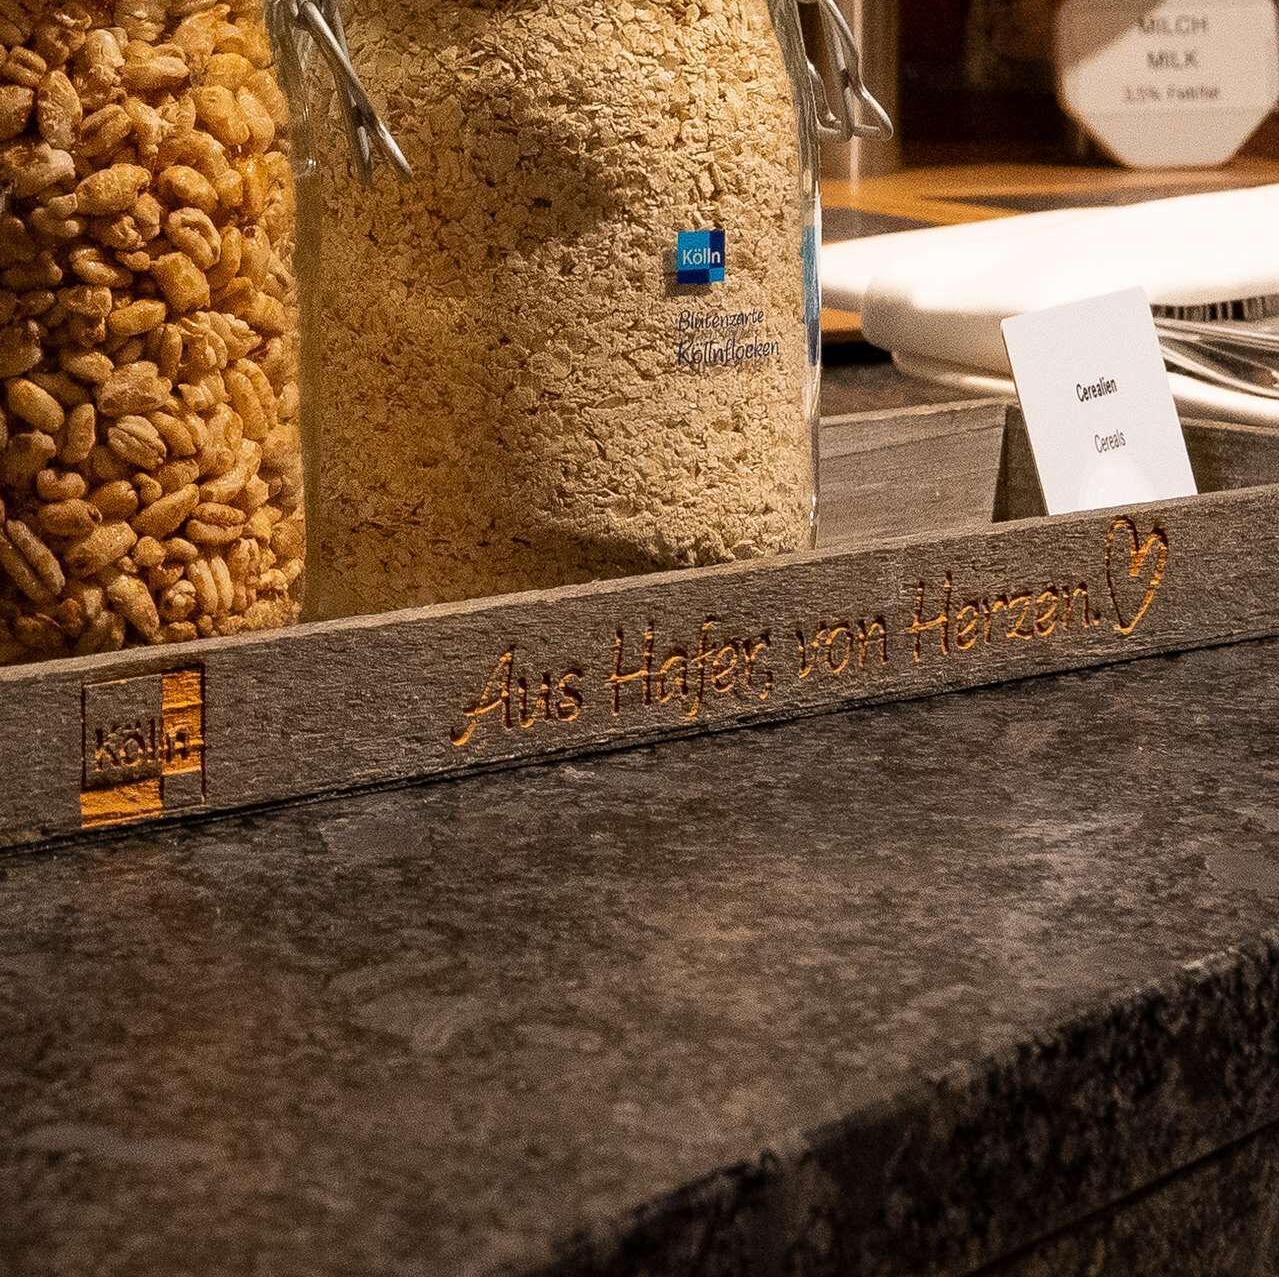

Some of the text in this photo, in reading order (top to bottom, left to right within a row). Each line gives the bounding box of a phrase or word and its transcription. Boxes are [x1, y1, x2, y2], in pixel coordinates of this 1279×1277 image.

[682, 249, 721, 266] Kölln
[677, 308, 765, 332] Blütenzarte
[677, 335, 780, 366] Köllnflocken
[1075, 376, 1118, 403] Cerealien
[1093, 428, 1127, 454] Cereals
[450, 643, 586, 748] Aus
[795, 612, 890, 681] von
